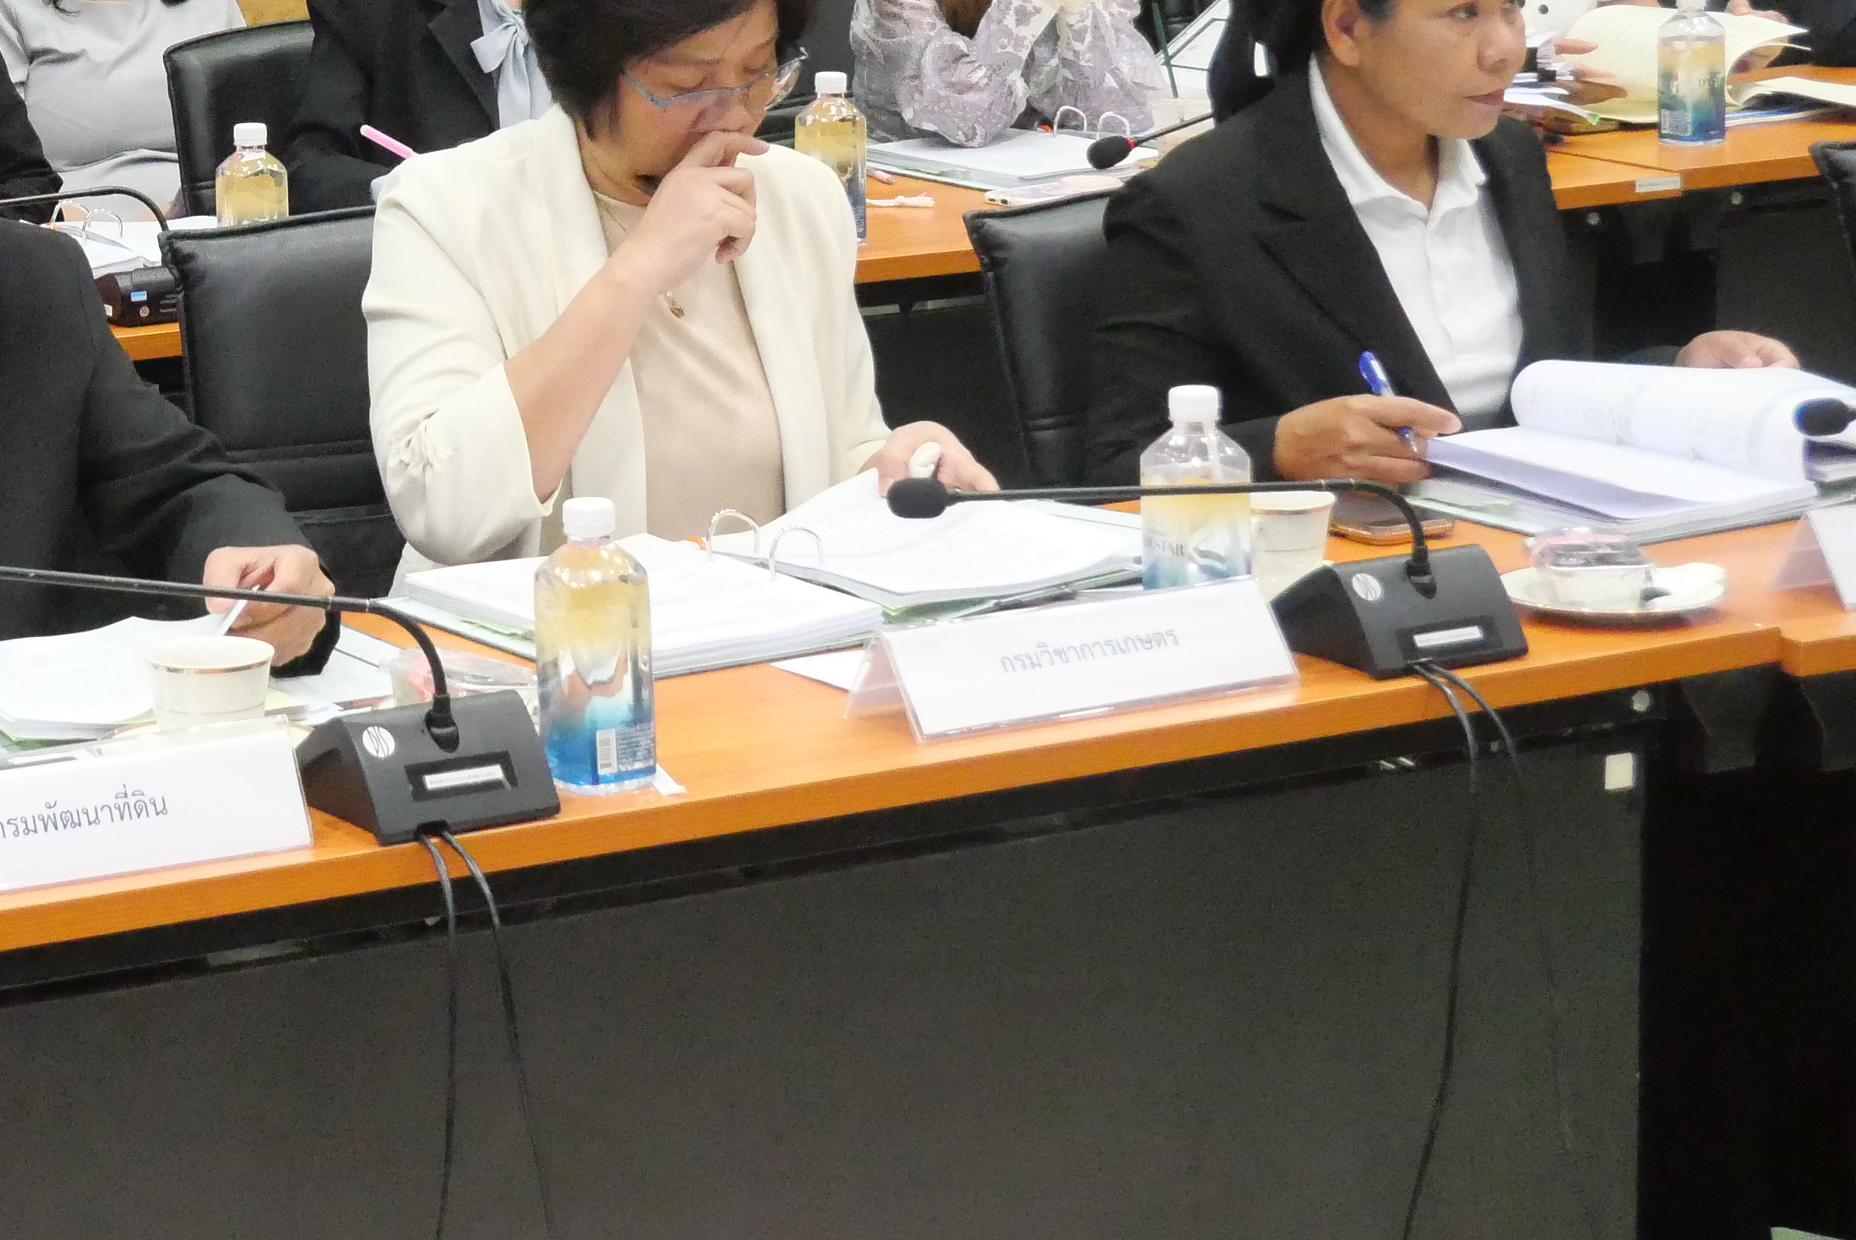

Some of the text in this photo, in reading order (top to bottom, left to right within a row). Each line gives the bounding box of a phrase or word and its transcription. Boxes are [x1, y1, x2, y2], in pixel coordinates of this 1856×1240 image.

[998, 626, 1180, 675] กรมวิชาการเกษตร
